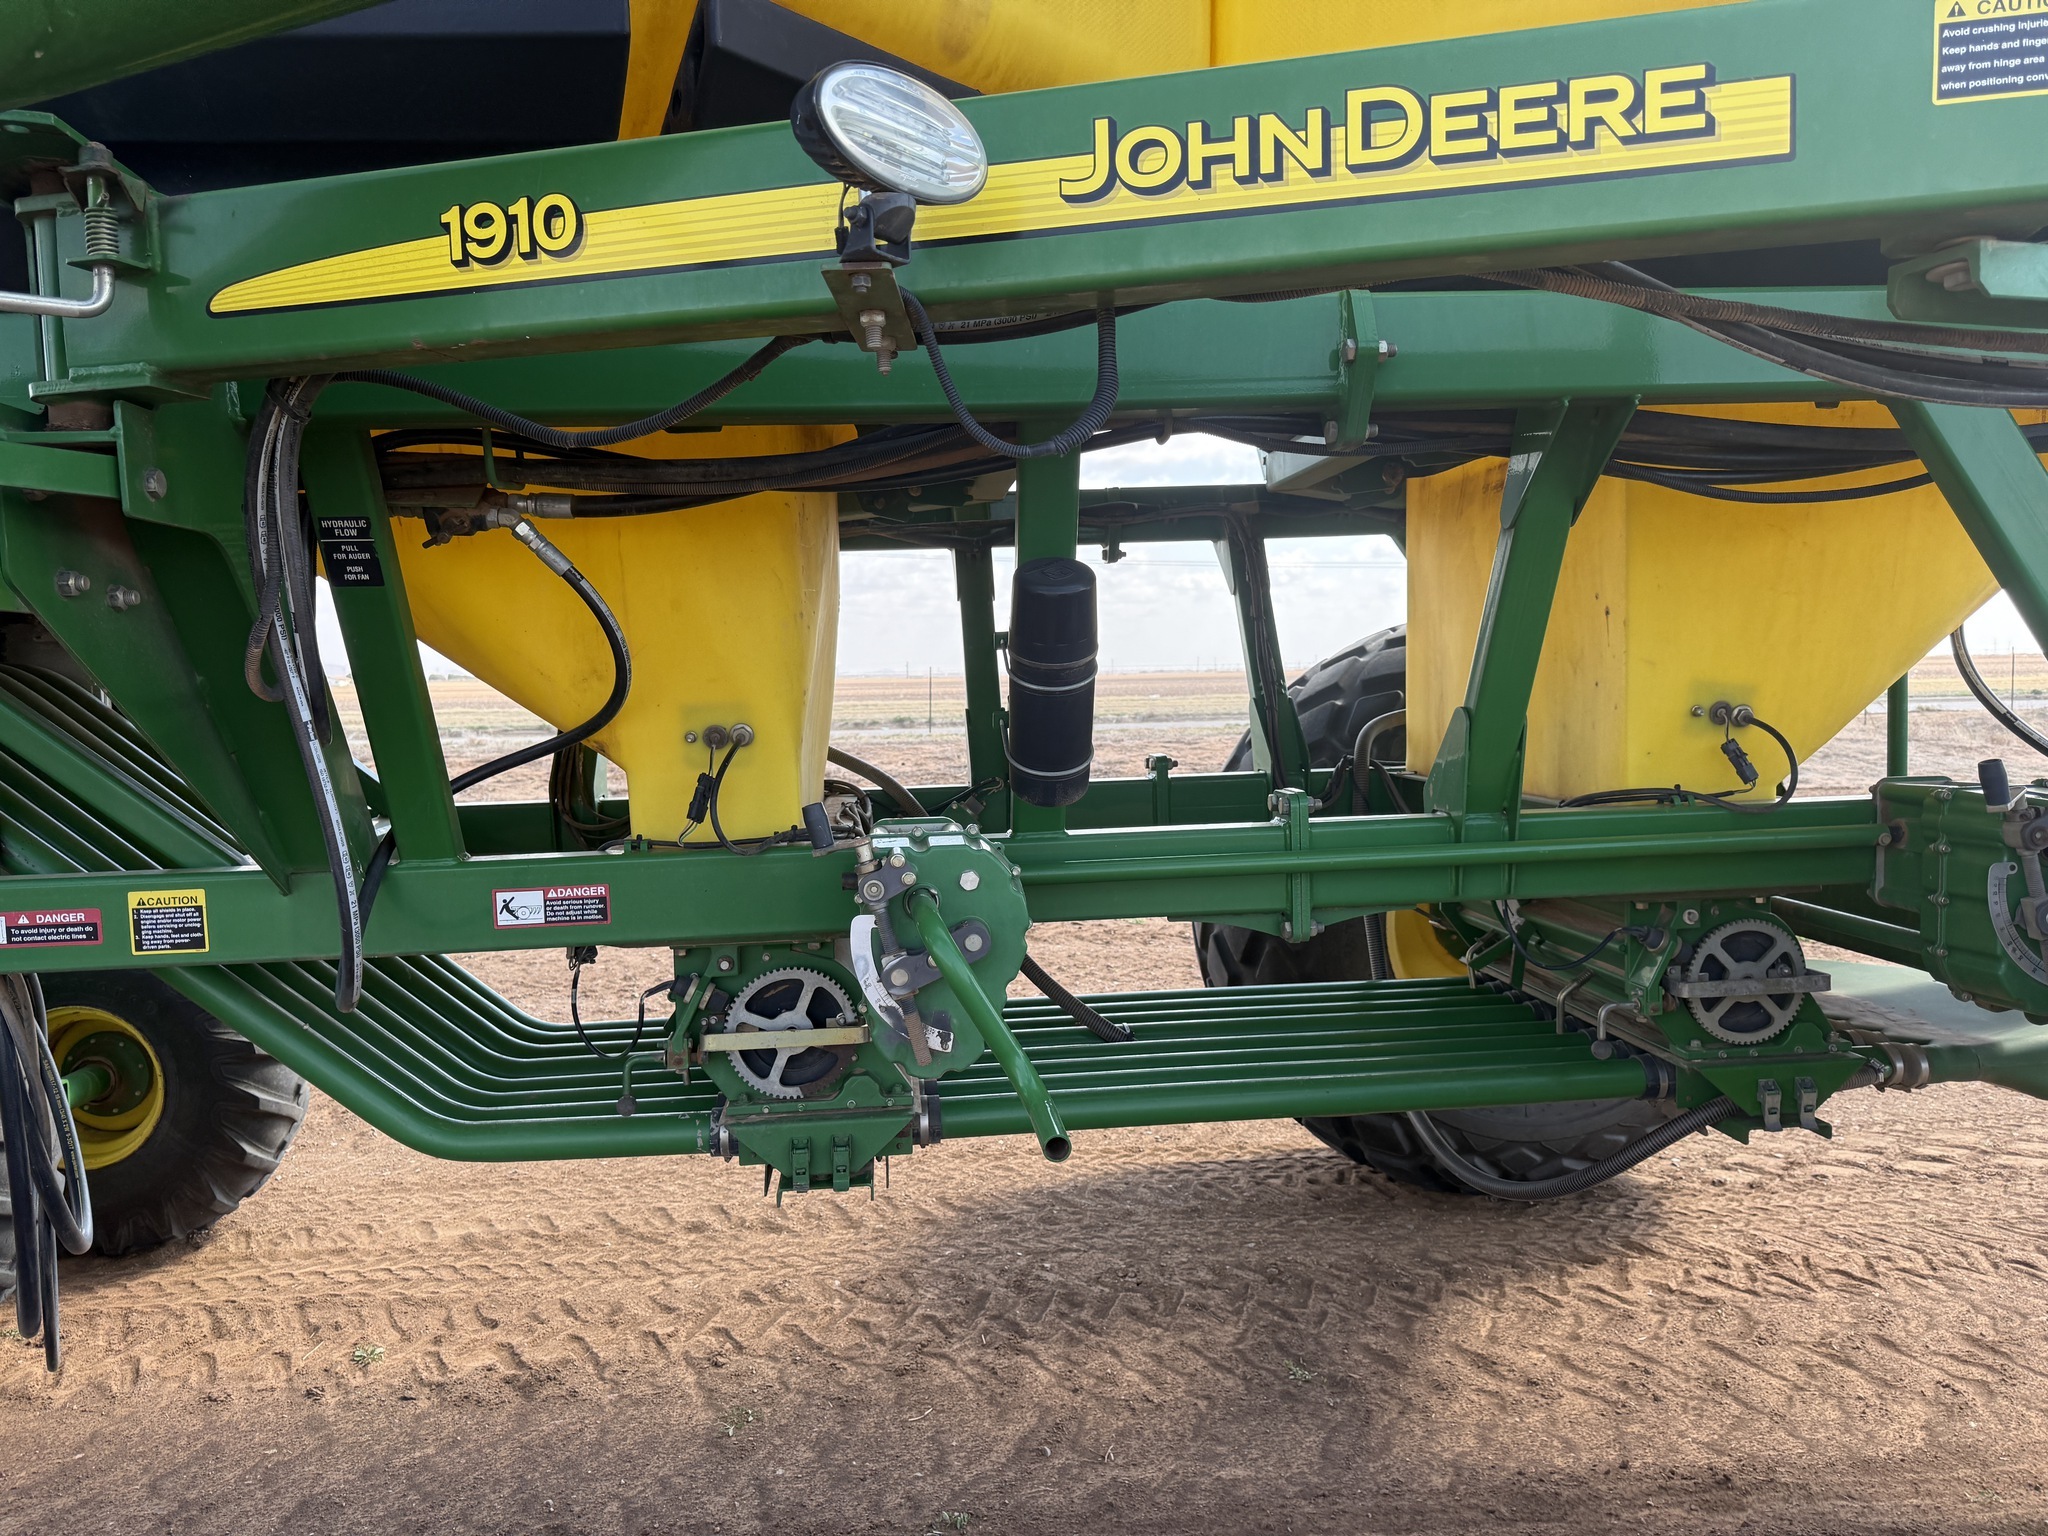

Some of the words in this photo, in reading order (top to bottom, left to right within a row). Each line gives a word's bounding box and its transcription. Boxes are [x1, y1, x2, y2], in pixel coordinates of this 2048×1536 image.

[1942, 27, 1970, 38] Avoid
[1972, 23, 2015, 35] crushing
[1942, 46, 1967, 55] Keep
[1969, 42, 1999, 52] hands
[2001, 40, 2020, 49] and
[1941, 64, 1966, 73] away
[1968, 61, 1991, 70] from
[1993, 58, 2021, 67] hinge
[2023, 56, 2045, 64] area
[1941, 81, 1966, 90] when
[1969, 75, 2024, 89] positioning
[1059, 105, 1329, 203] JOHN
[1345, 62, 1715, 173] DEERE
[440, 193, 582, 266] 1910
[960, 321, 970, 329] 21
[973, 319, 992, 328] MPa
[994, 316, 1017, 326] (3000
[321, 520, 367, 528] HYDRAULIC
[334, 528, 357, 536] FLOW
[557, 887, 606, 897] DANGER
[147, 896, 198, 906] CAUTION
[36, 913, 85, 923] DANGER
[39, 927, 57, 935] injury
